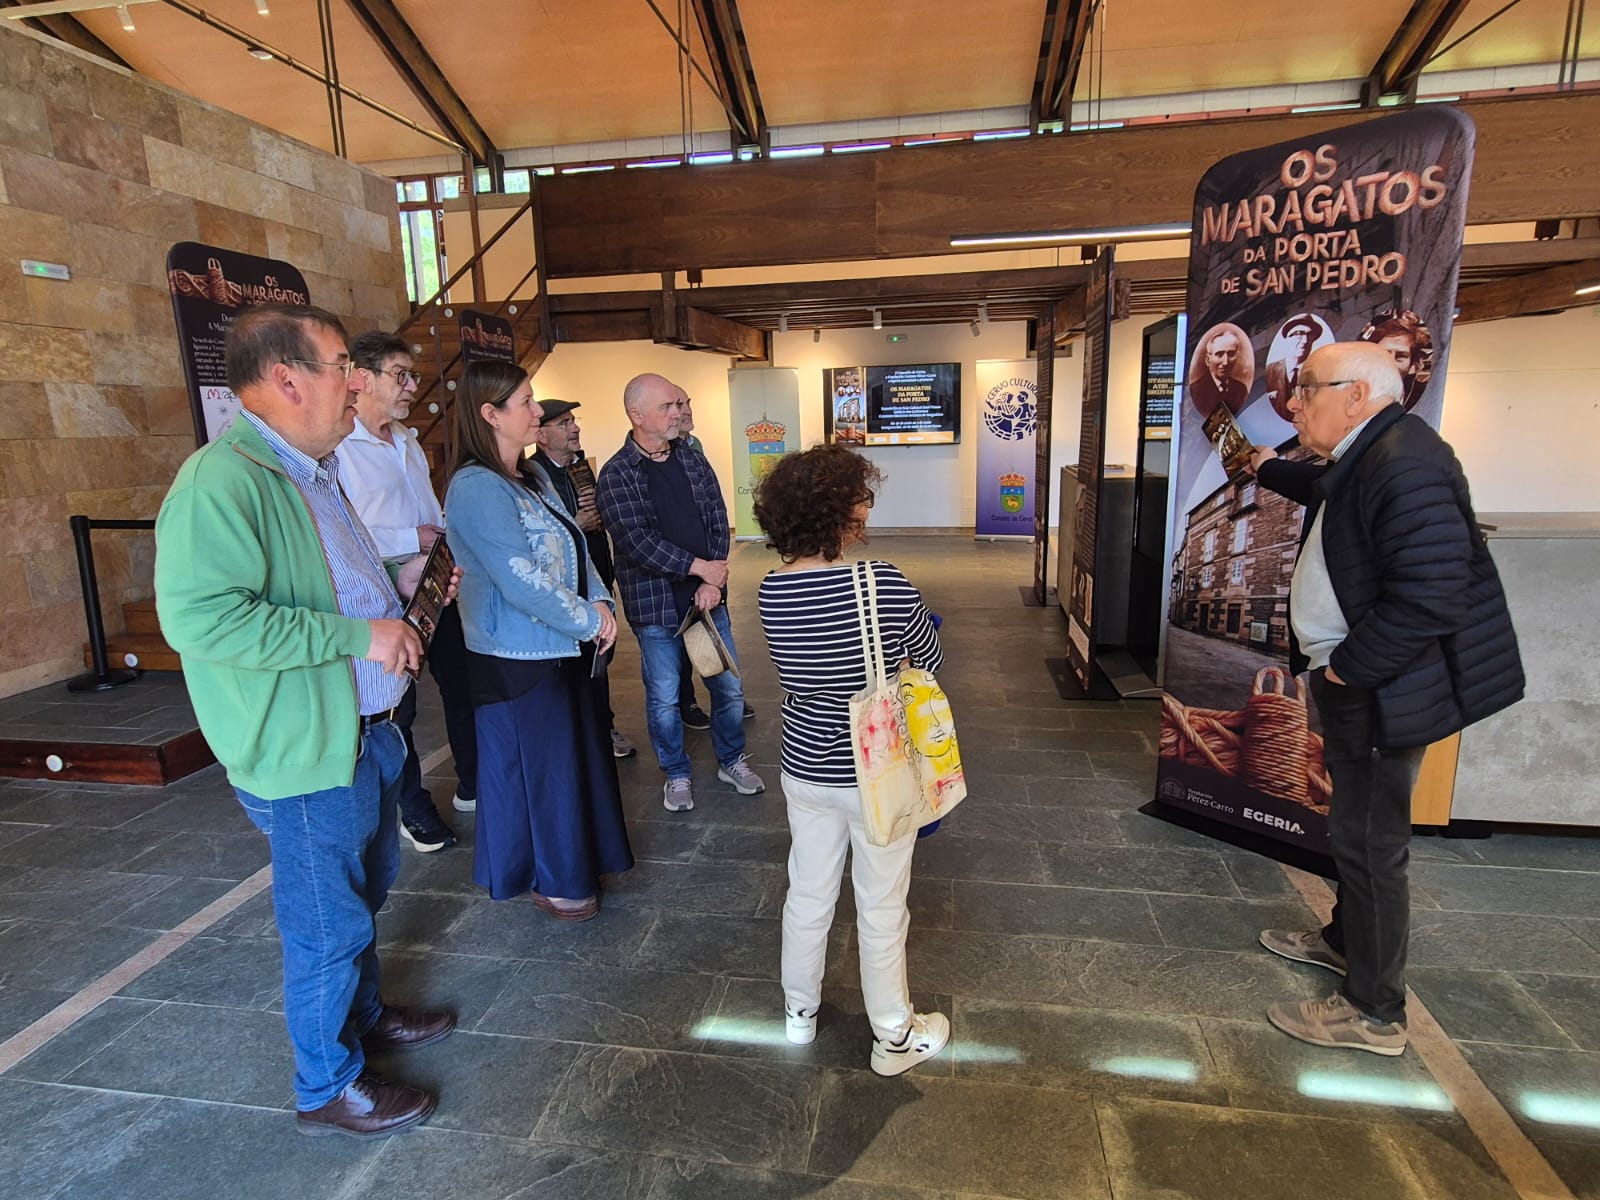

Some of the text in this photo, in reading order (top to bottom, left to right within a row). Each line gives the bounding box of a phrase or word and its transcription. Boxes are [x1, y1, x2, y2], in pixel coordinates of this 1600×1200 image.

[1280, 144, 1338, 189] OS
[1201, 165, 1448, 246] MARAGATOS
[1243, 228, 1362, 264] DA PORTA
[264, 275, 279, 287] OS
[1220, 251, 1408, 297] DE SAN PEDRO
[242, 283, 306, 305] MARAGATOS
[987, 380, 1009, 400] CERVO
[1243, 807, 1304, 834] EGERIA
